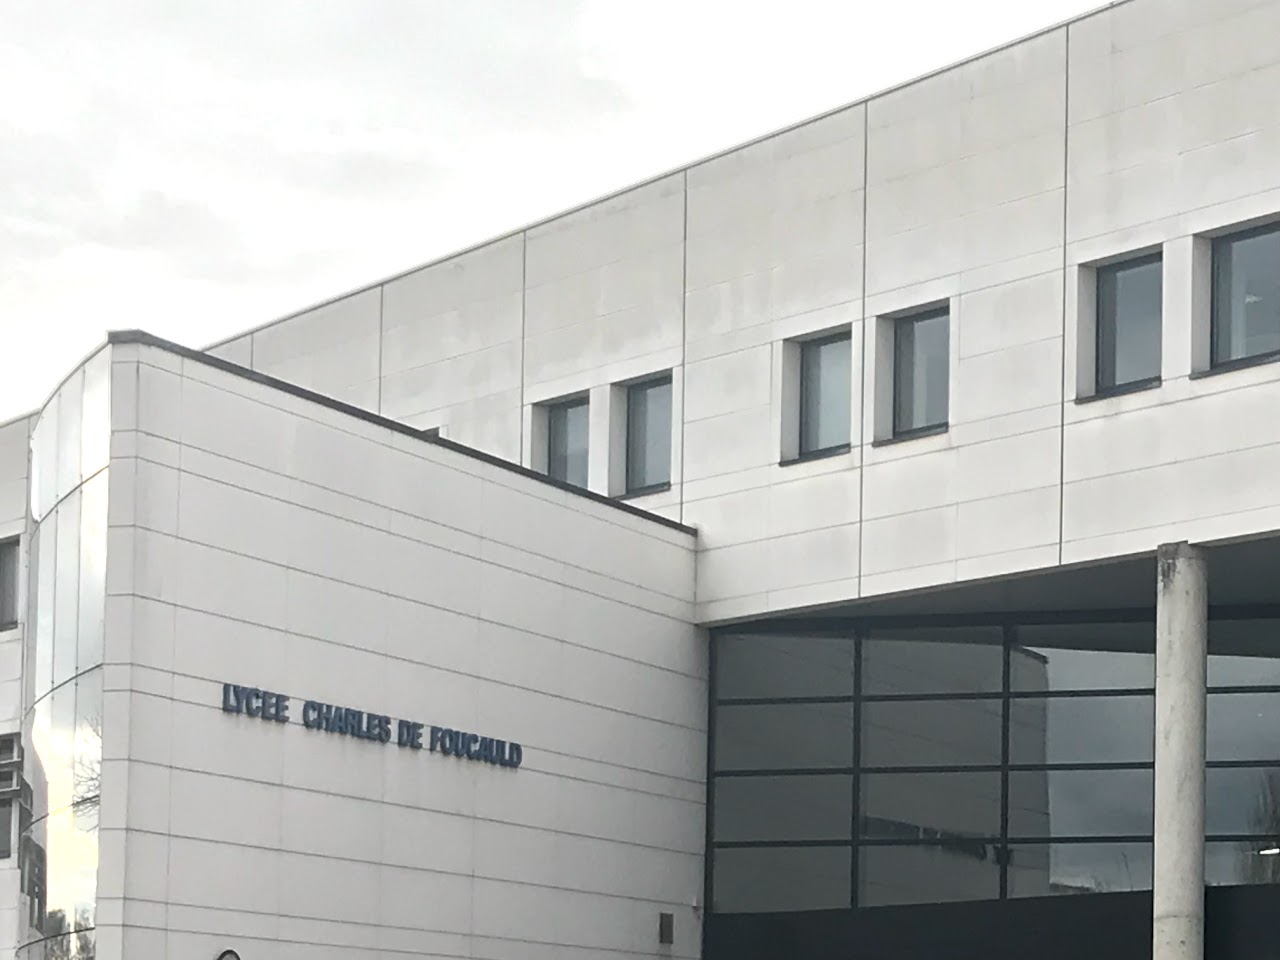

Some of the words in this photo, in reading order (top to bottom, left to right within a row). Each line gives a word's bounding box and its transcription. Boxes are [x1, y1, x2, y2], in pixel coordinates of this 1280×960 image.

[222, 683, 290, 722] LYCEE
[302, 700, 391, 743] CHARLES
[397, 719, 424, 749] DE
[429, 726, 523, 768] FOUCAULD
